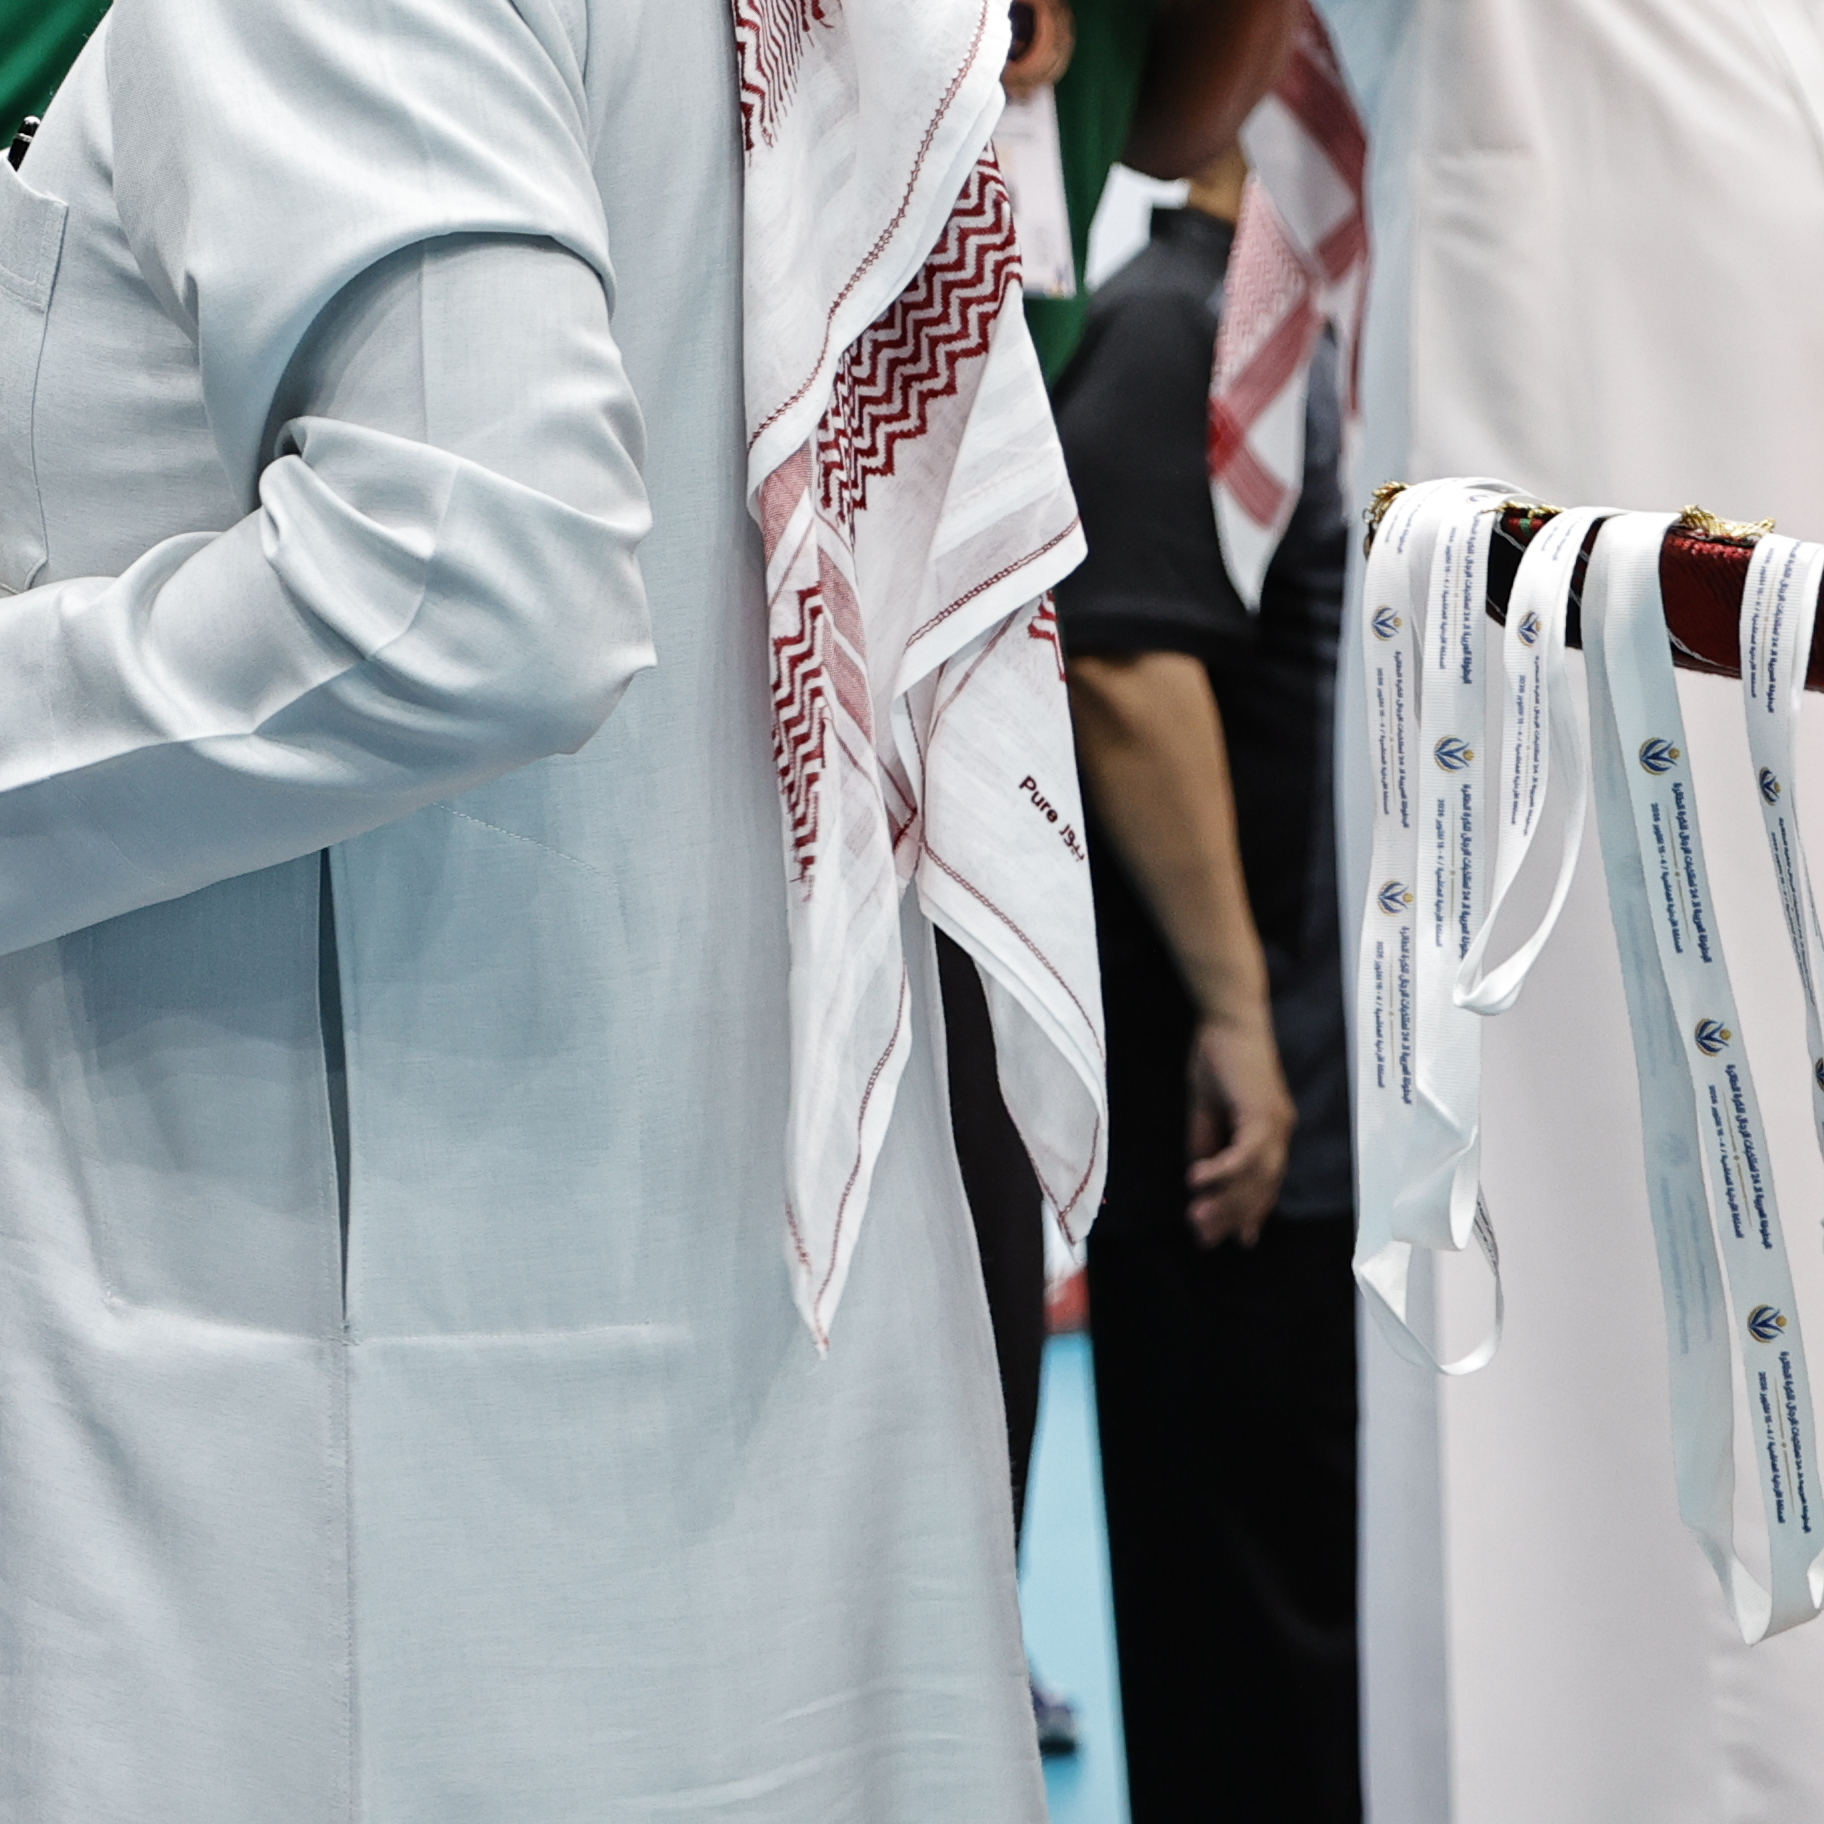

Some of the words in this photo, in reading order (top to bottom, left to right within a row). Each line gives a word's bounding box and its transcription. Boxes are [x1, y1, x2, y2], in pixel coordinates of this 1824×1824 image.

[1018, 775, 1058, 823] Pure
[1688, 888, 1700, 899] 24
[1750, 1173, 1762, 1184] 24
